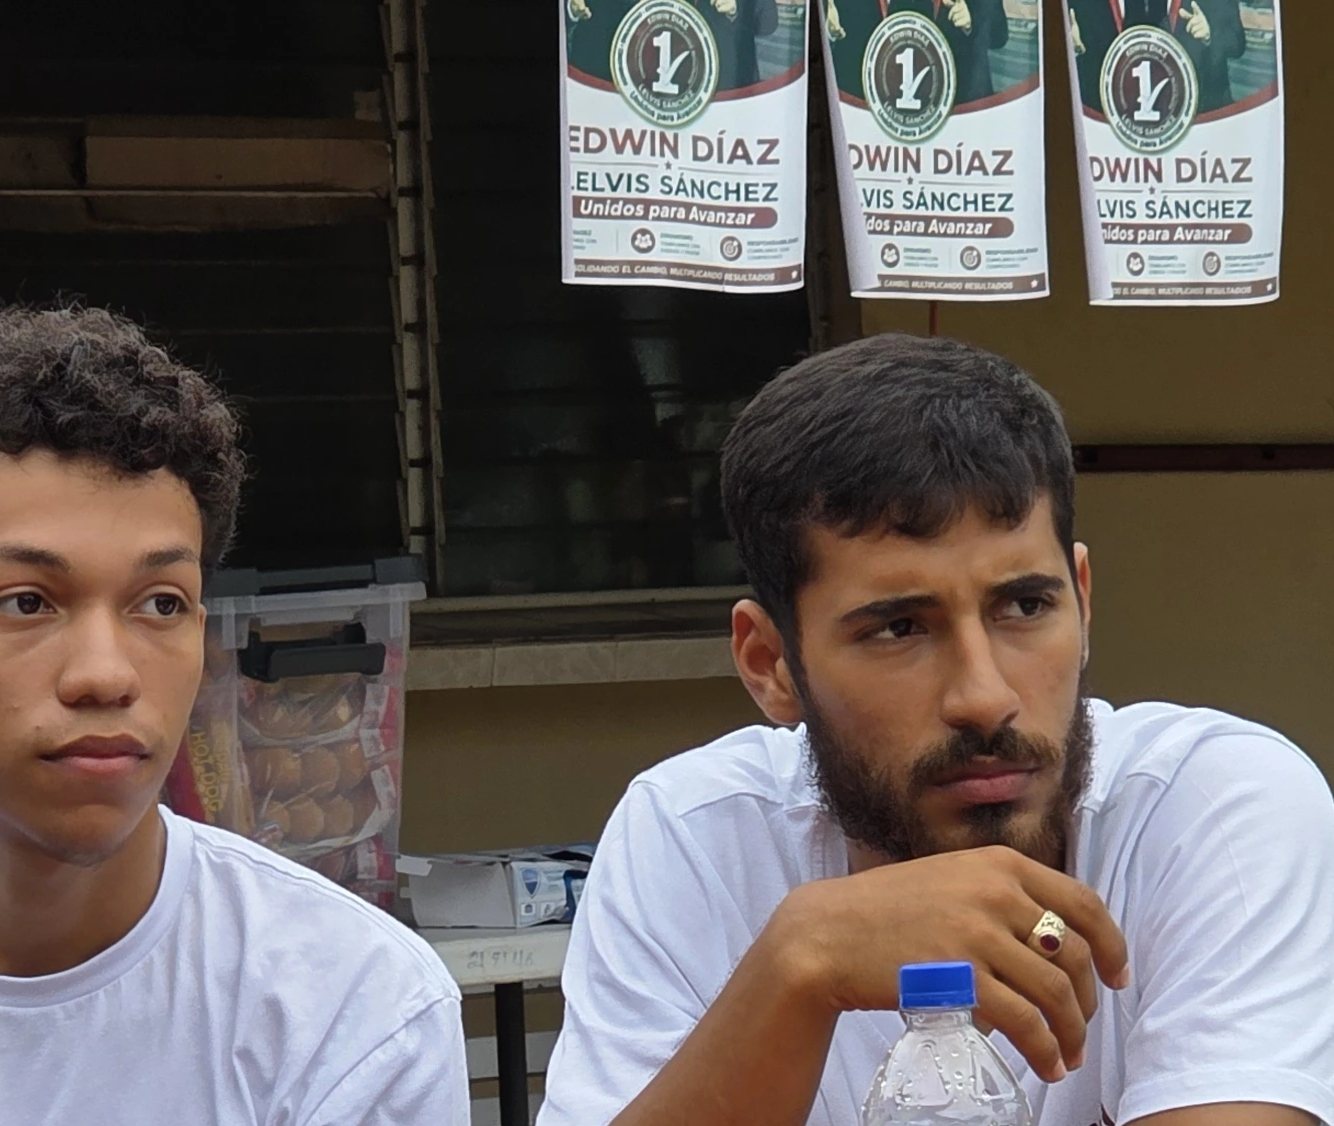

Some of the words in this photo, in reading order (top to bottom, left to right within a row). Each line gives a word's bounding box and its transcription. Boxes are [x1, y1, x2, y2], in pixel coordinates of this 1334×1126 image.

[652, 31, 679, 95] 1
[896, 48, 921, 110] 1
[1132, 61, 1160, 121] 1
[692, 129, 780, 165] DÍAZ
[848, 144, 921, 174] DWIN
[933, 142, 1014, 176] DÍAZ
[1089, 156, 1163, 183] DWIN
[1175, 151, 1253, 183] DÍAZ
[572, 171, 650, 193] ELVIS
[660, 172, 779, 202] SÁNCHEZ
[862, 188, 894, 209] VIS
[902, 187, 1014, 212] SÁNCHEZ
[580, 199, 644, 216] Unidos
[649, 204, 685, 220] para
[689, 206, 755, 225] Avanzar
[1097, 198, 1137, 219] LVIS
[1145, 195, 1253, 219] SÁNCHEZ
[867, 216, 891, 232] dos
[893, 219, 925, 235] para
[928, 219, 992, 235] Avanzar
[1102, 225, 1134, 241] nidos
[1137, 228, 1170, 244] para
[1173, 227, 1232, 242] Avanzar
